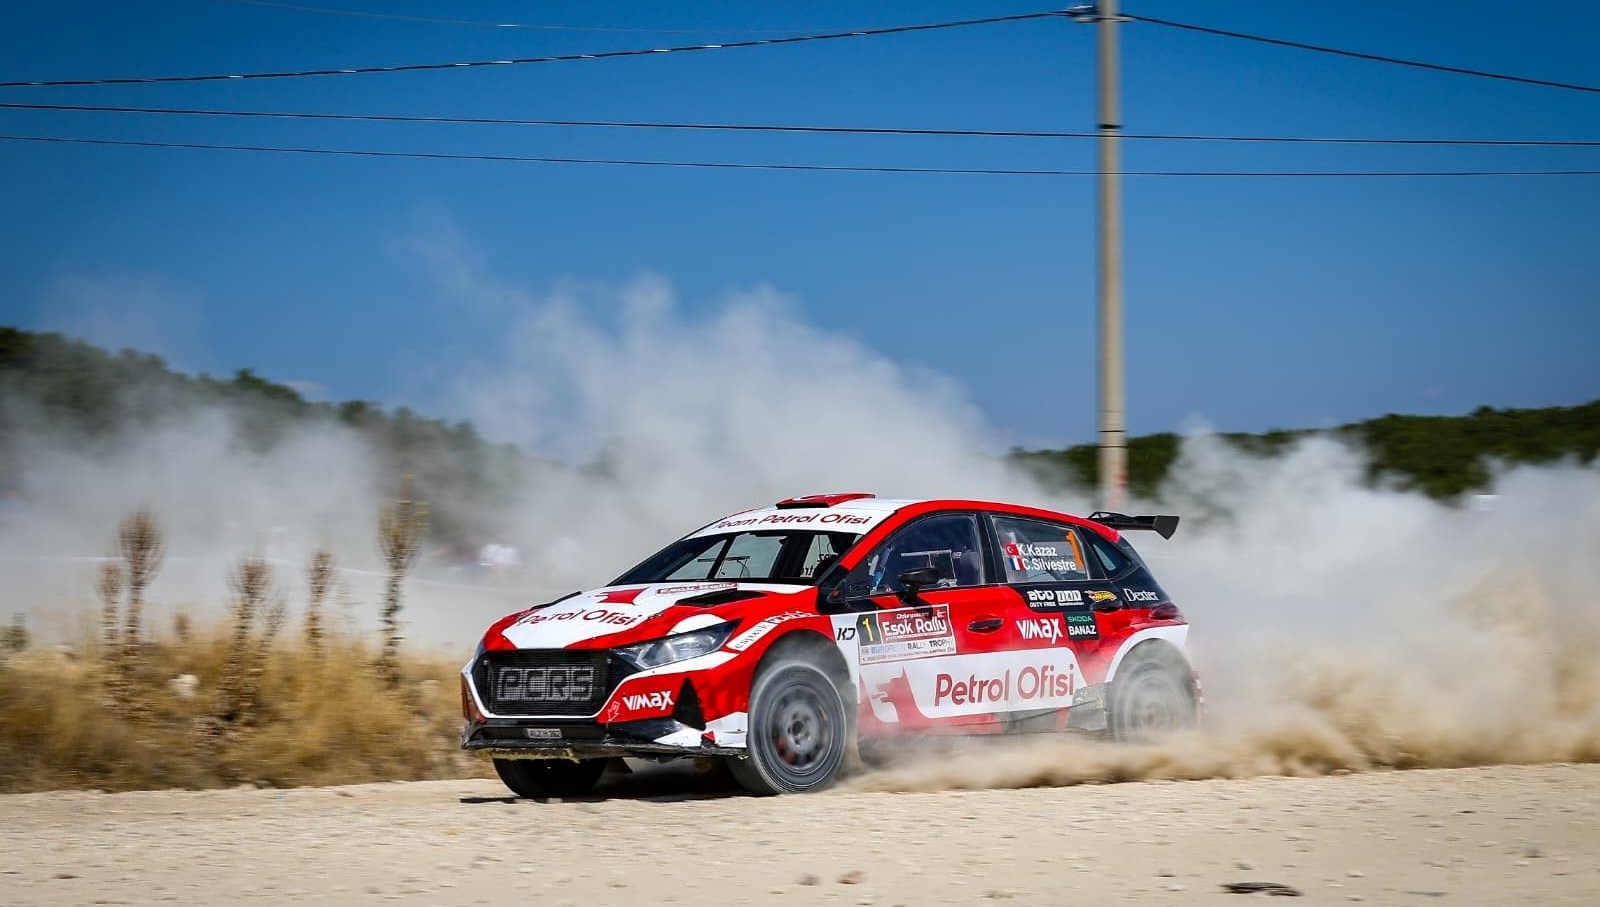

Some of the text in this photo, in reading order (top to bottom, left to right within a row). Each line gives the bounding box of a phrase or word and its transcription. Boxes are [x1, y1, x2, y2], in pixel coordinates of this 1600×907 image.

[712, 513, 873, 530] Team Petrol Ofisi
[1017, 543, 1058, 557] K.Kazaz
[1066, 531, 1083, 569] 1
[1023, 556, 1077, 571] C.Silvestre
[1123, 588, 1159, 601] Dexter
[583, 609, 642, 626] Ofisi
[882, 616, 947, 636] Esok Rally
[862, 618, 874, 641] 1
[1068, 626, 1097, 636] BANAZ
[934, 663, 1075, 707] Petrol Ofisi
